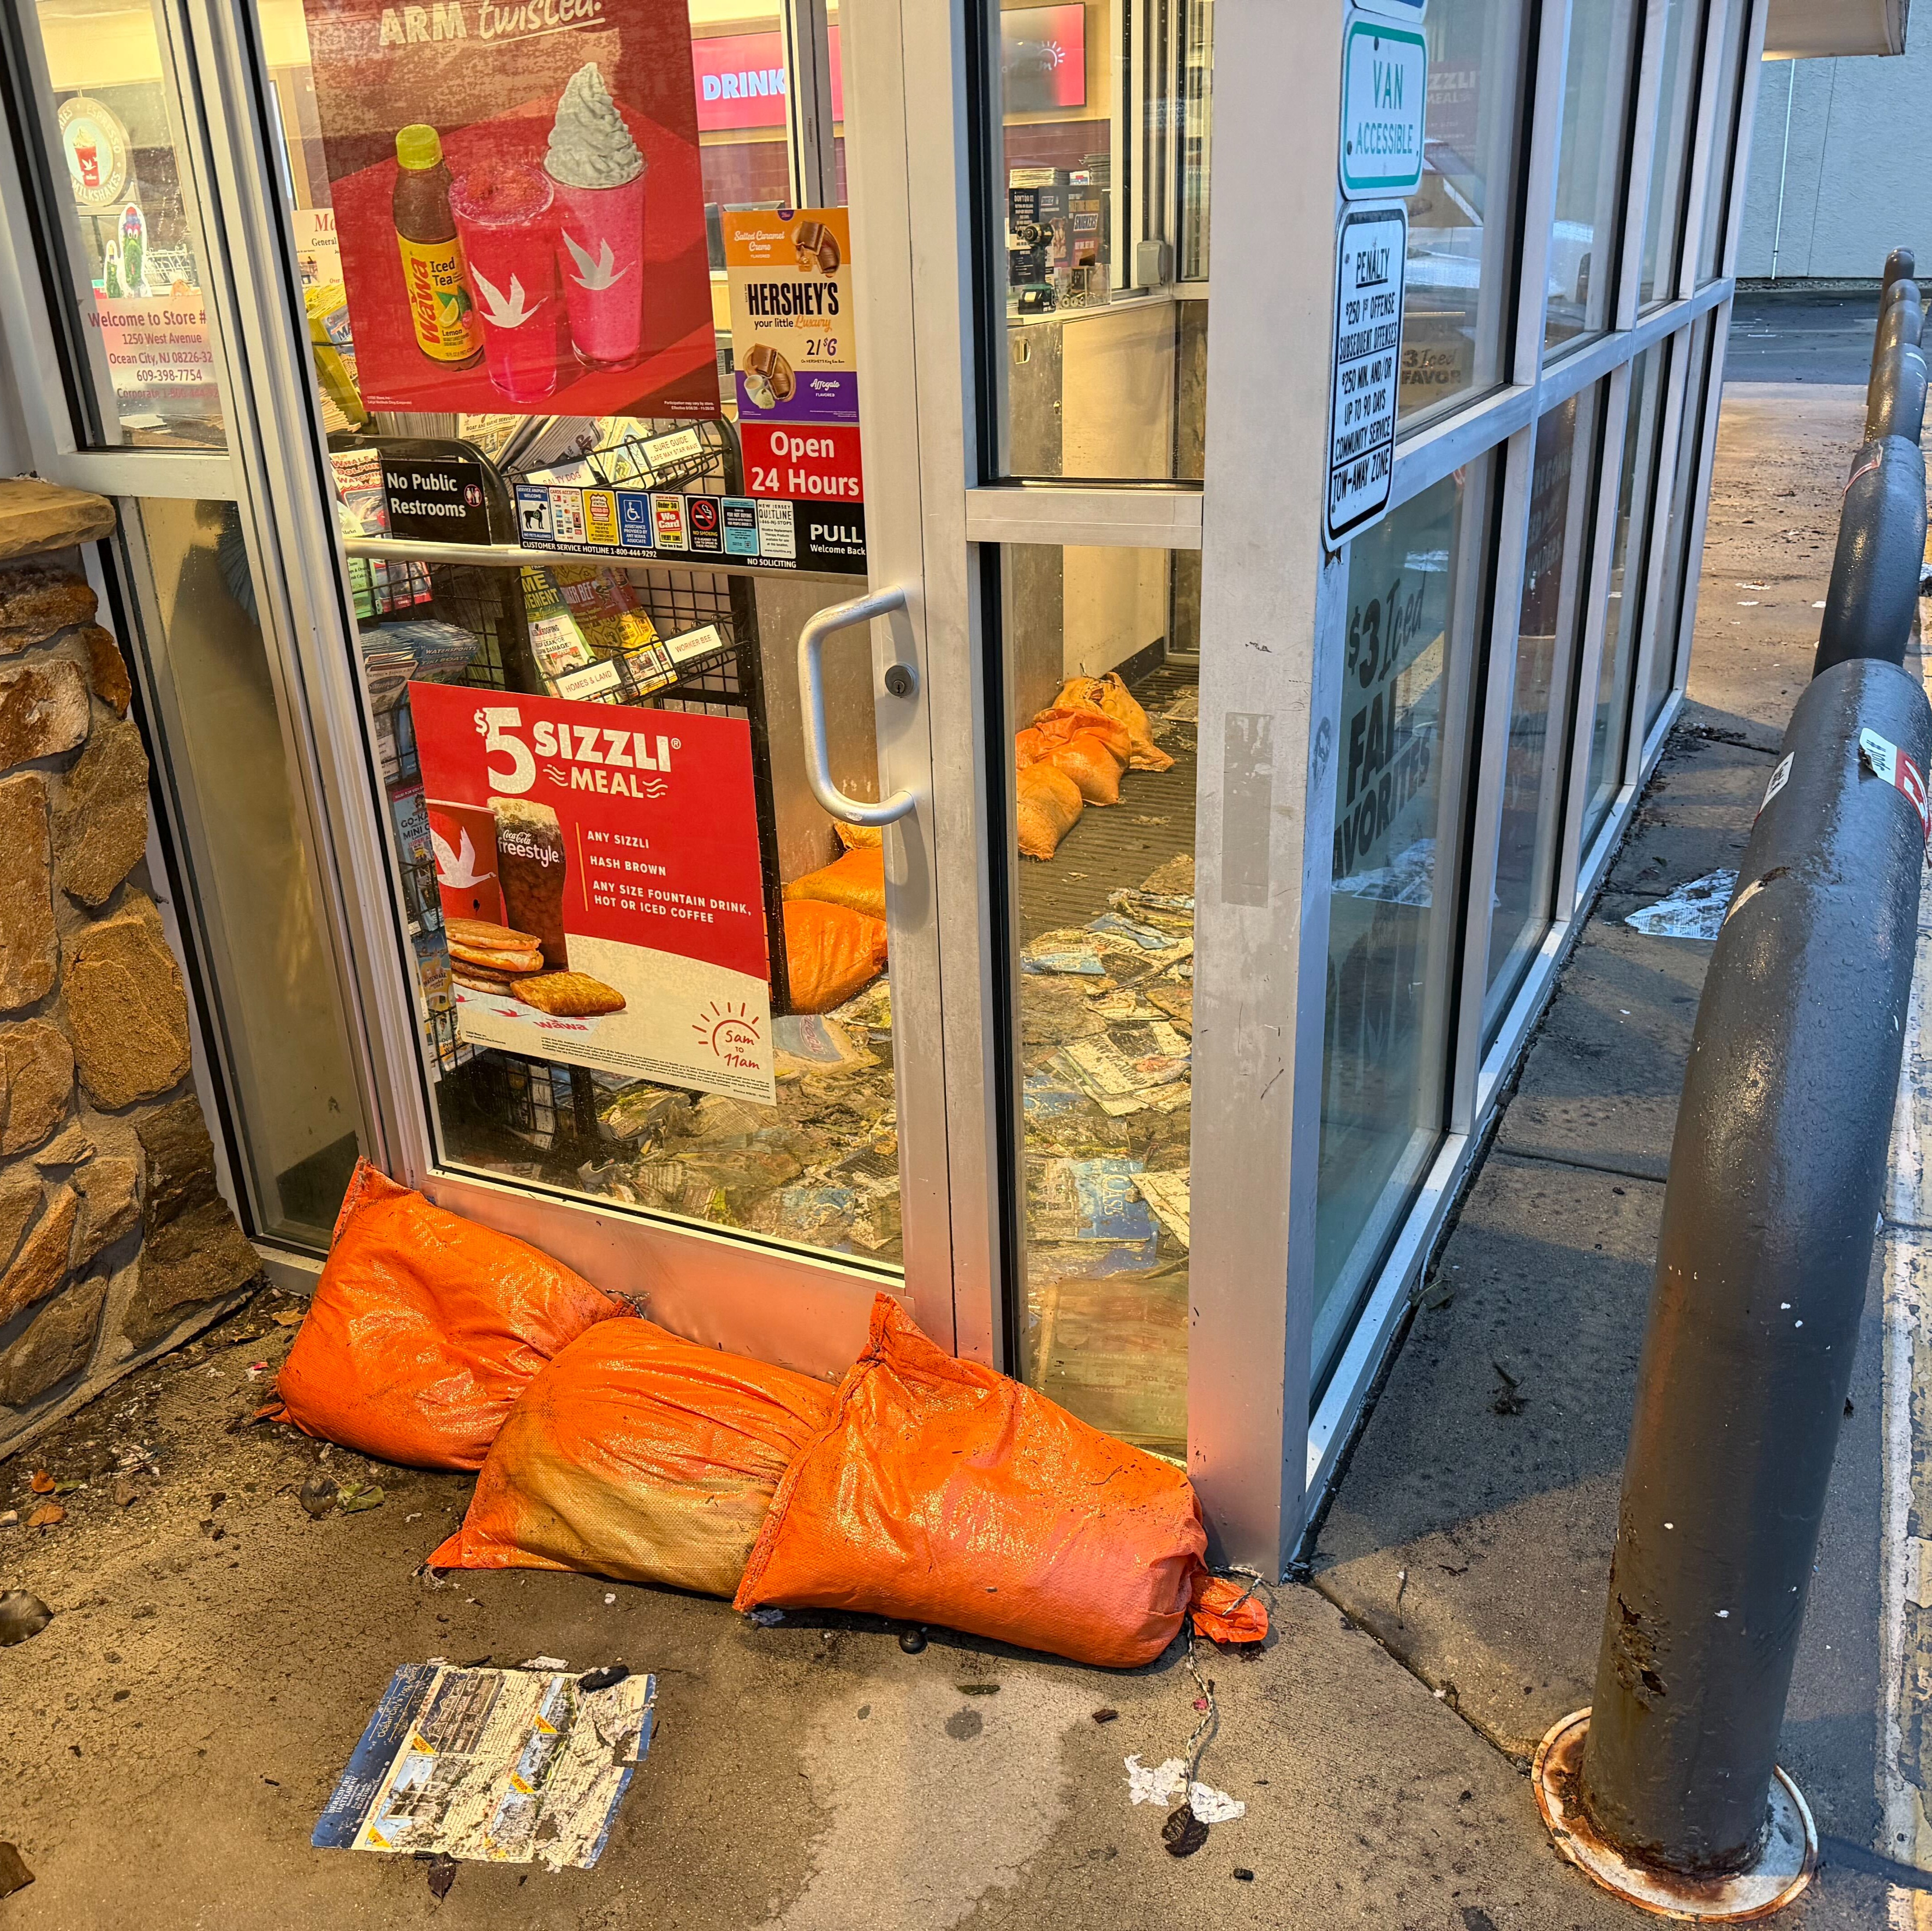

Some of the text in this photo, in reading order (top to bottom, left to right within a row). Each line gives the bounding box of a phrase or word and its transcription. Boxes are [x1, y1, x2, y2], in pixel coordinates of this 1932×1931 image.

[379, 2, 468, 46] ARM
[702, 68, 786, 101] DRINK
[1373, 59, 1403, 110] VAN
[87, 105, 121, 154] ESPRESSO
[1356, 122, 1413, 155] ACCESSIBLE
[72, 171, 121, 202] MILKSHAKES
[311, 237, 337, 247] General
[734, 230, 785, 241] Salted Caramel
[749, 241, 772, 252] Creme
[429, 257, 455, 272] Iced
[1356, 248, 1390, 283] PENALTY
[432, 275, 453, 287] Tea
[747, 282, 839, 316] HERSHEY'S
[1346, 292, 1396, 325] $250 OFFENSE
[88, 309, 207, 327] Welcome to Store #
[754, 315, 832, 333] your little Luxury
[122, 333, 202, 344] 1250 West Avenue
[1338, 321, 1397, 361] SUBSEQUENT OFFENSES
[110, 353, 137, 364] Ocean
[138, 352, 158, 366] City,
[159, 353, 170, 363] NJ
[137, 369, 202, 381] 609-398-7754
[1342, 357, 1392, 395] $250 MIN. AND/OR
[117, 388, 160, 399] Corporate
[810, 379, 840, 391] Affogato
[1344, 389, 1386, 426] UP TO 90 DAYS
[498, 415, 516, 424] SERVICES
[653, 435, 689, 452] SURE GUIDE
[770, 431, 834, 463] Open
[1335, 416, 1391, 462] COMMUNITY SERVICE
[331, 456, 370, 468] WHALE
[650, 453, 662, 462] CAPE
[674, 447, 685, 455] STAR
[387, 472, 458, 492] No Public
[543, 471, 581, 485] SALTY DOG
[751, 467, 859, 496] 24 Hours
[1333, 447, 1390, 503] TOW-AWAY ZONE
[390, 498, 466, 517] Restrooms
[658, 501, 670, 509] Under
[758, 509, 792, 520] QUITLINE
[661, 512, 676, 521] We
[810, 524, 863, 543] PULL
[523, 541, 657, 558] CUSTOMER SERVICE HOTLINE 1-800-444-9292
[810, 544, 866, 555] Welcome Back
[759, 558, 797, 568] SOLICITING
[1347, 571, 1425, 689] $3 Iced
[425, 645, 478, 654] WATERSPORTS
[675, 635, 713, 653] WORKER BEE
[565, 678, 589, 693] HOMES
[594, 670, 612, 682] LAND
[474, 707, 536, 794] $5
[571, 766, 644, 799] MEAL
[403, 826, 423, 840] MINI
[588, 830, 649, 849] ANY SIZZLI
[590, 855, 666, 876] HASH BROWN
[593, 880, 752, 916] ANY SIZE FOUNTAIN DRINK,
[594, 895, 714, 924] HOT OR ICED COFFEE
[725, 1030, 755, 1045] 5am
[724, 1053, 760, 1070] 11am
[378, 1715, 393, 1738] Ocean
[390, 1698, 404, 1715] City's
[335, 1776, 359, 1813] HATHAWAY
